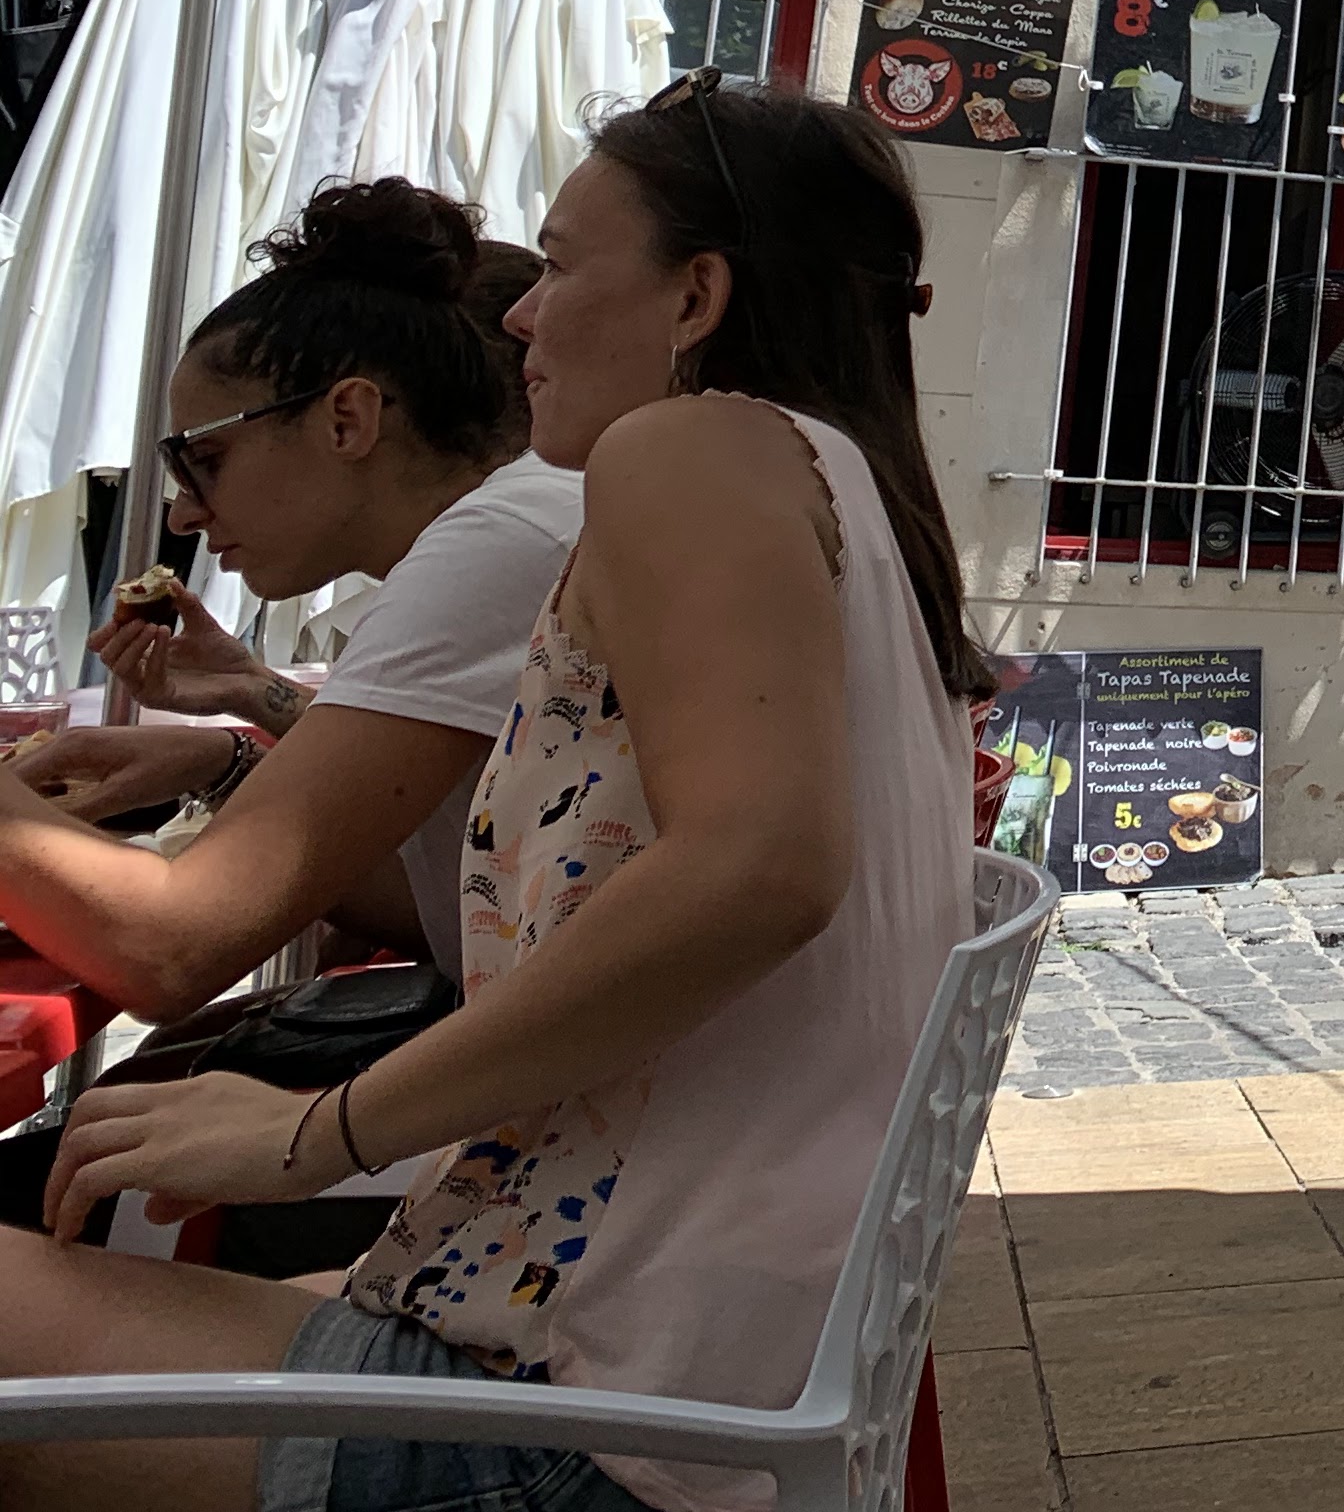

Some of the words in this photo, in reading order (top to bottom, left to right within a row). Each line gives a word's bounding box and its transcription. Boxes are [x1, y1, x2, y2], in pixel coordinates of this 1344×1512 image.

[1009, 4, 1054, 20] Coppa
[930, 10, 987, 27] Rillettes
[1014, 20, 1053, 35] Mans
[995, 34, 1028, 48] lapin
[1119, 655, 1205, 668] Assortiment
[1211, 653, 1229, 665] de
[1097, 671, 1151, 693] Tapas
[1159, 667, 1250, 691] Tapenade
[1097, 691, 1169, 705] uniquement
[1174, 690, 1203, 704] pour
[1088, 718, 1155, 737] Tapenade
[1160, 718, 1195, 730] verte
[1088, 740, 1155, 757] Tapenade
[1165, 738, 1203, 749] noire
[1087, 758, 1167, 773] Poivronade
[1087, 781, 1144, 794] Tomates
[1150, 778, 1201, 792] séchées
